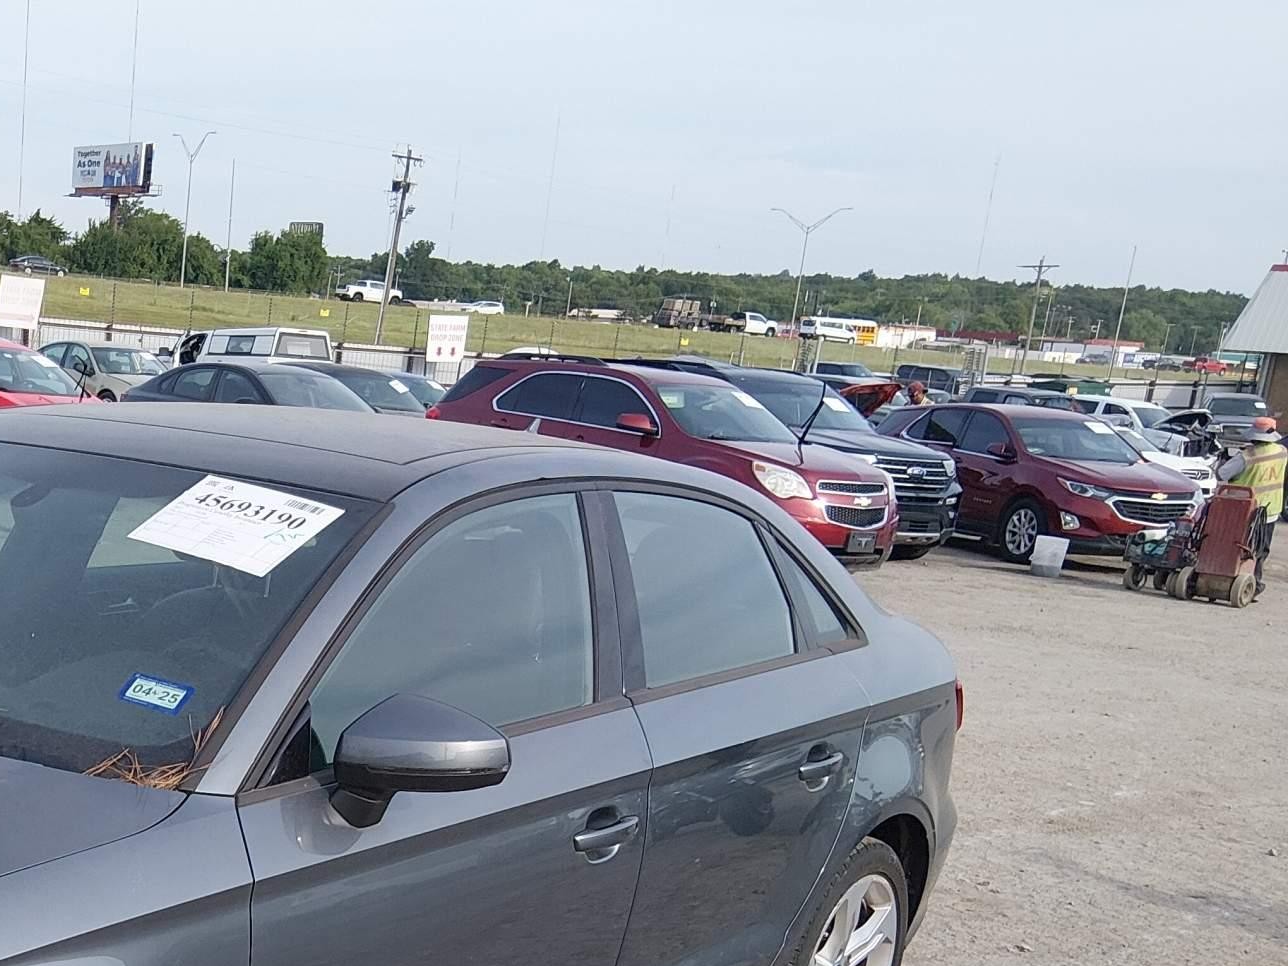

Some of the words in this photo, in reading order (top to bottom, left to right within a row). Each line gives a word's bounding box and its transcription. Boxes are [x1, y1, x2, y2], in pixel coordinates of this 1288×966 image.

[77, 150, 102, 158] Together
[77, 160, 86, 168] As
[87, 159, 101, 168] One
[194, 493, 307, 530] 45693190
